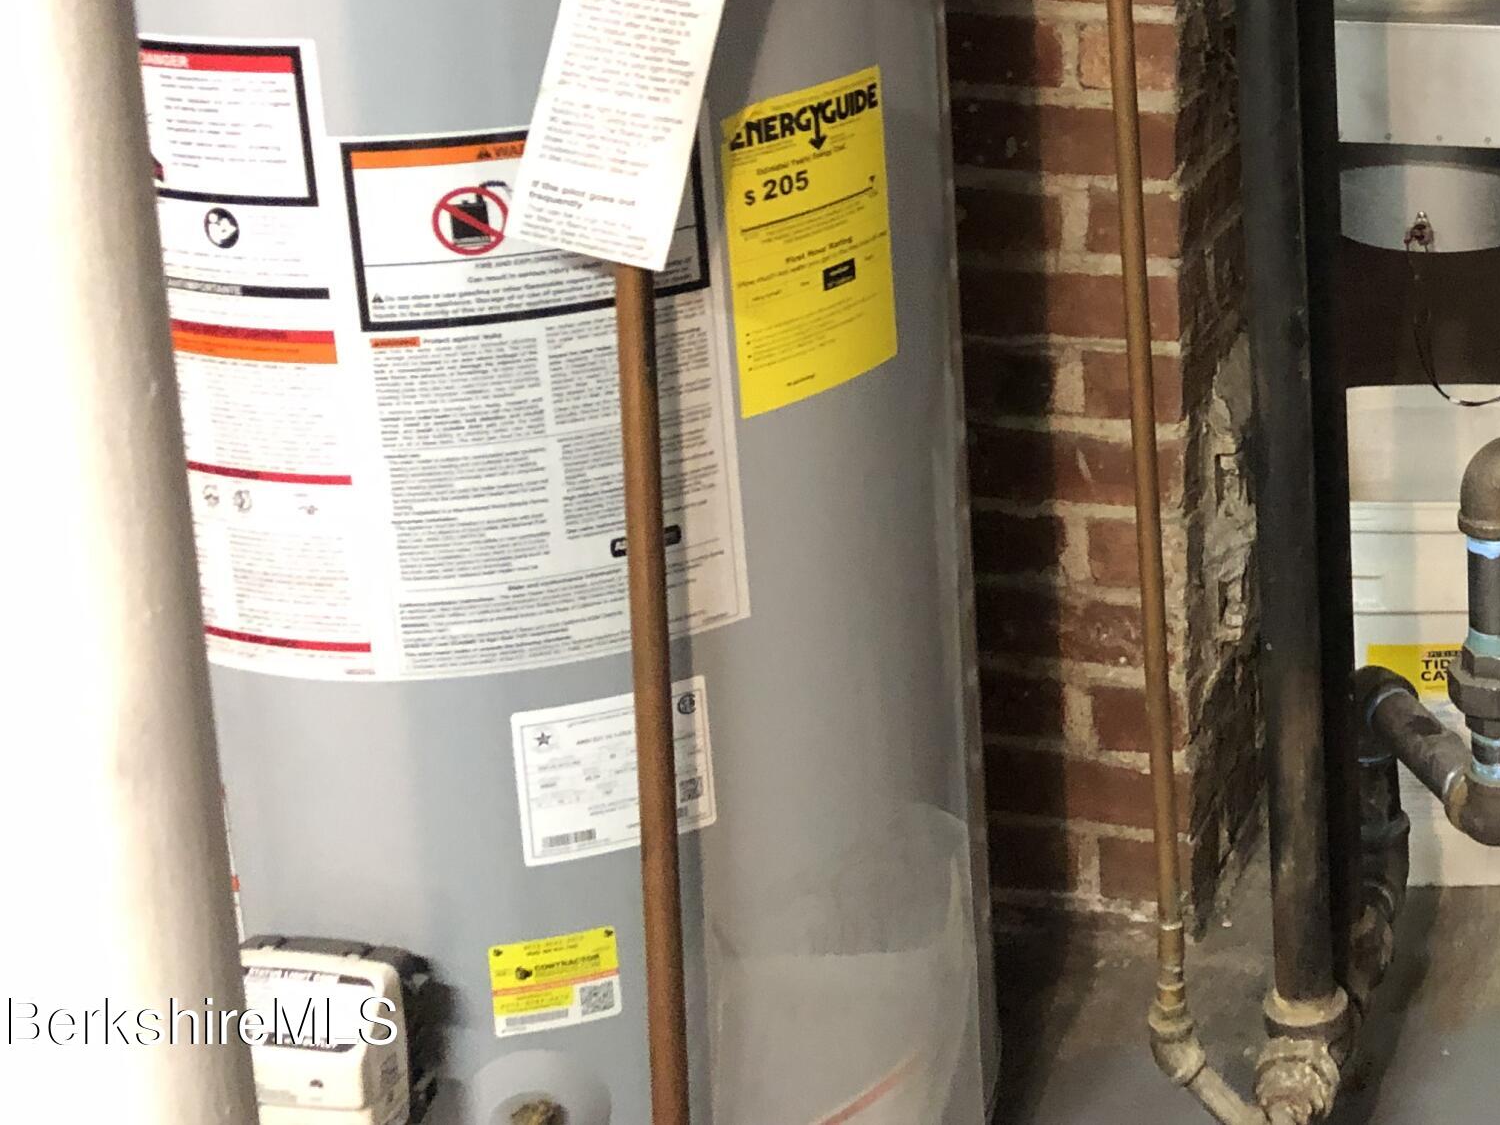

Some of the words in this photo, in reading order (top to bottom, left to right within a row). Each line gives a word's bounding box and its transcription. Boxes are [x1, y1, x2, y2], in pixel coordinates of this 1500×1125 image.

[763, 170, 809, 201] 205
[1421, 659, 1451, 670] TID
[1421, 670, 1448, 682] CA
